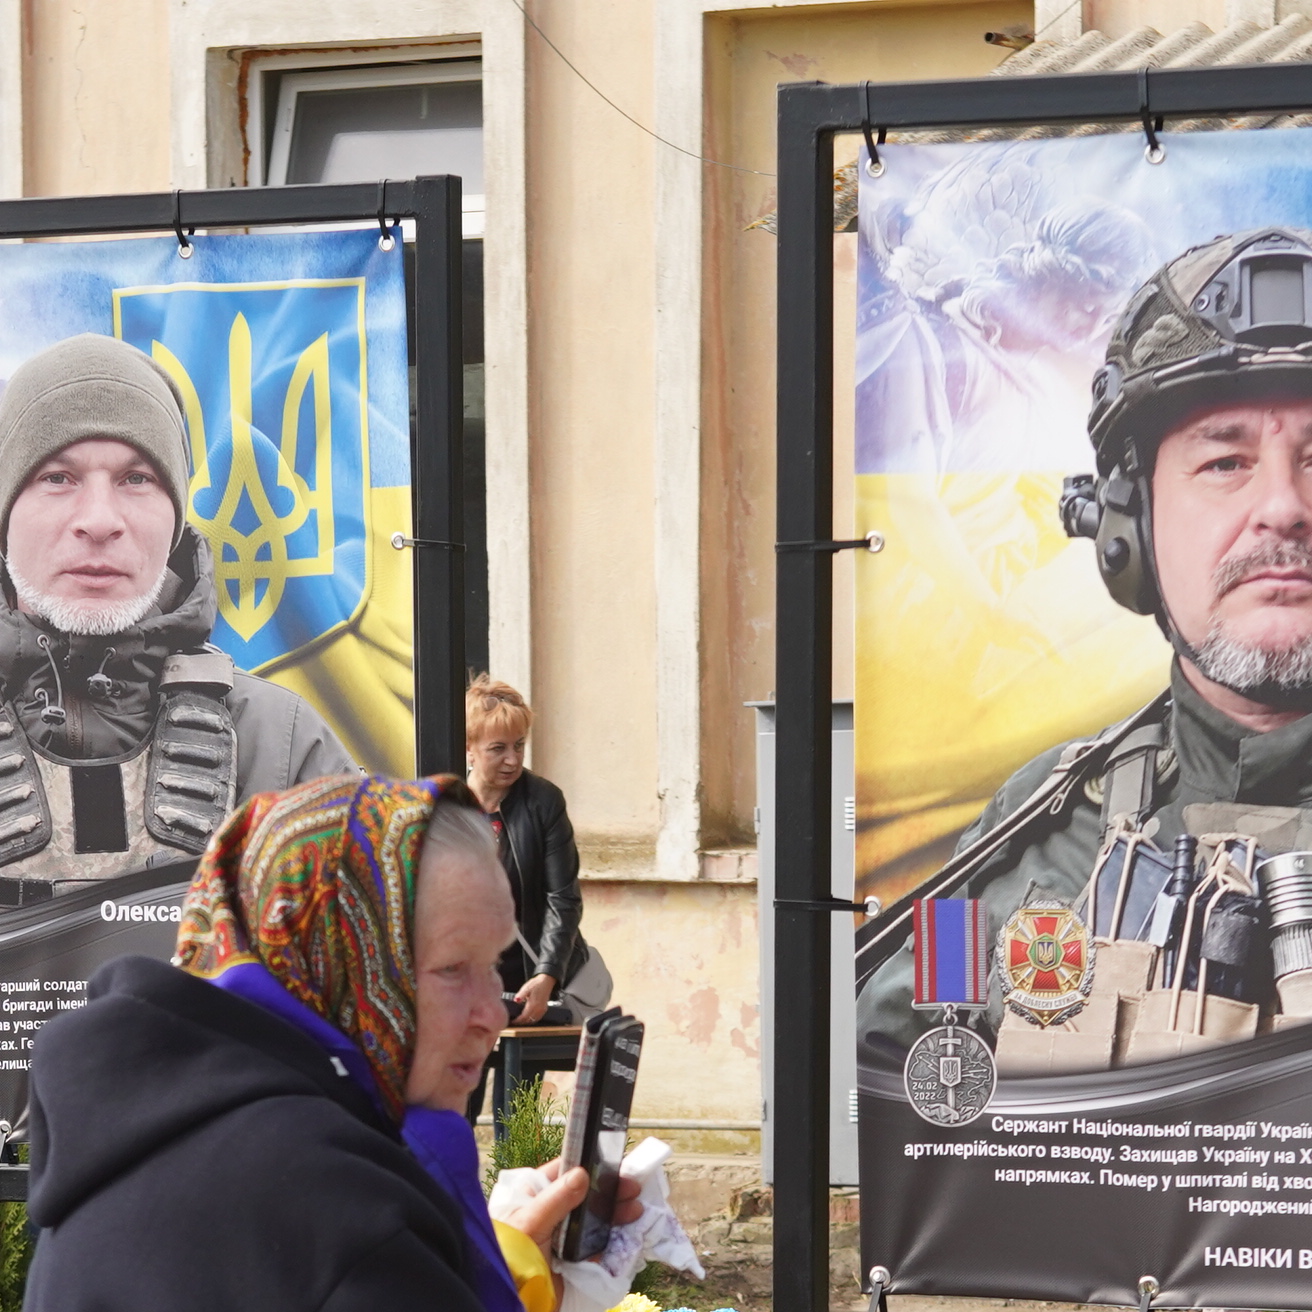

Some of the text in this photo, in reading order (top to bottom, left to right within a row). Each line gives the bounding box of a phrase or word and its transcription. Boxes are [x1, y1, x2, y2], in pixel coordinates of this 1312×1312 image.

[100, 900, 182, 922] Олекса
[43, 980, 89, 993] солдат
[2, 998, 53, 1015] бригади
[991, 1116, 1069, 1135] Сержант
[1072, 1118, 1190, 1138] Національної
[1193, 1120, 1256, 1139] гвардії
[904, 1140, 1046, 1161] артилерійського
[1050, 1144, 1116, 1162] взводу.
[1119, 1146, 1198, 1164] Захищав
[1201, 1146, 1270, 1166] Україну
[1273, 1151, 1295, 1165] на
[994, 1168, 1095, 1186] напрямках.
[1099, 1169, 1158, 1190] Помер
[1161, 1174, 1172, 1192] у
[1175, 1172, 1248, 1190] шпиталі
[1252, 1173, 1280, 1191] від
[1203, 1246, 1293, 1269] НАВІКИ
